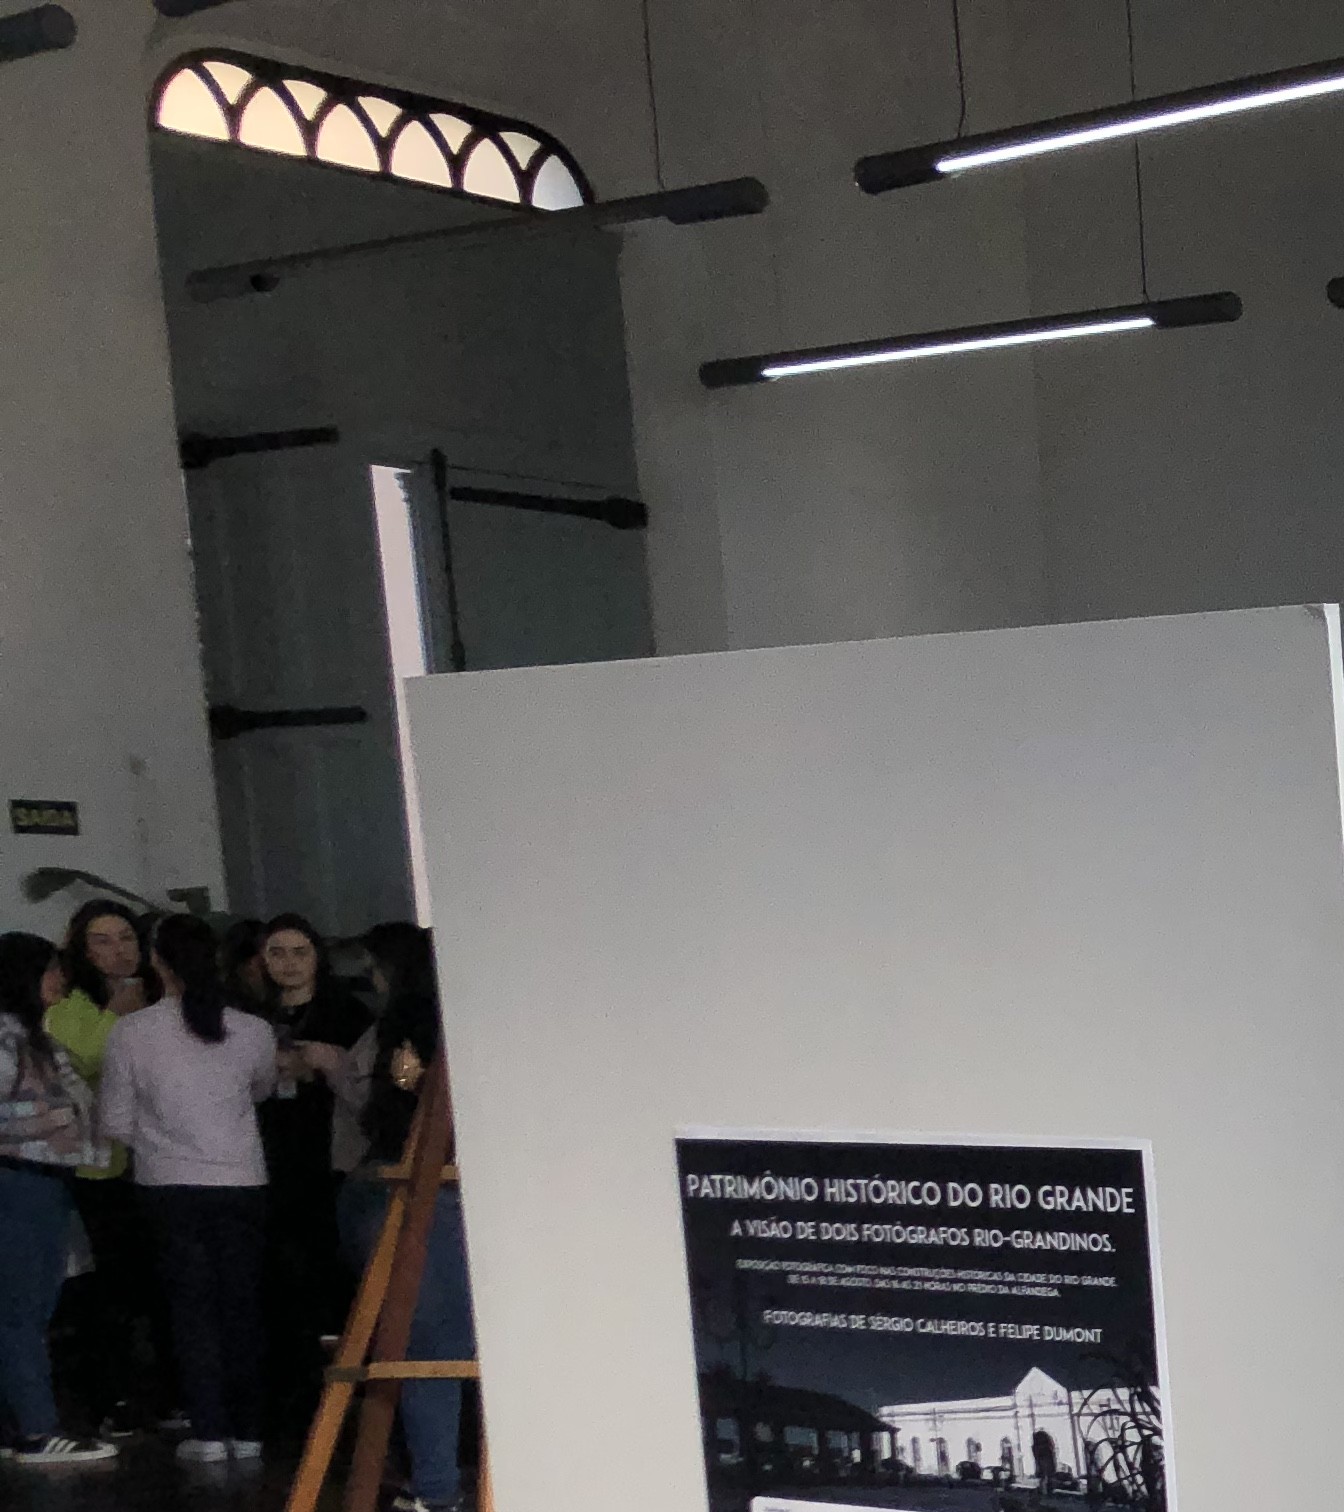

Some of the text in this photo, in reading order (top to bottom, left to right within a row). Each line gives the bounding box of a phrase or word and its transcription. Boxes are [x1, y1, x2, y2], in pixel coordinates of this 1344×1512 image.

[686, 1169, 1136, 1214] PATRIMÔNIO HISTÓRICO DO RIO GRANDE
[730, 1216, 1117, 1253] A VISÃO DE DOIS FOTÓGRAFOS RIO-GRANDINOS.
[762, 1309, 1103, 1344] FOTOGRAFIAS DE SÉRGIO CALHEIROS E FELIPE DUMONT
